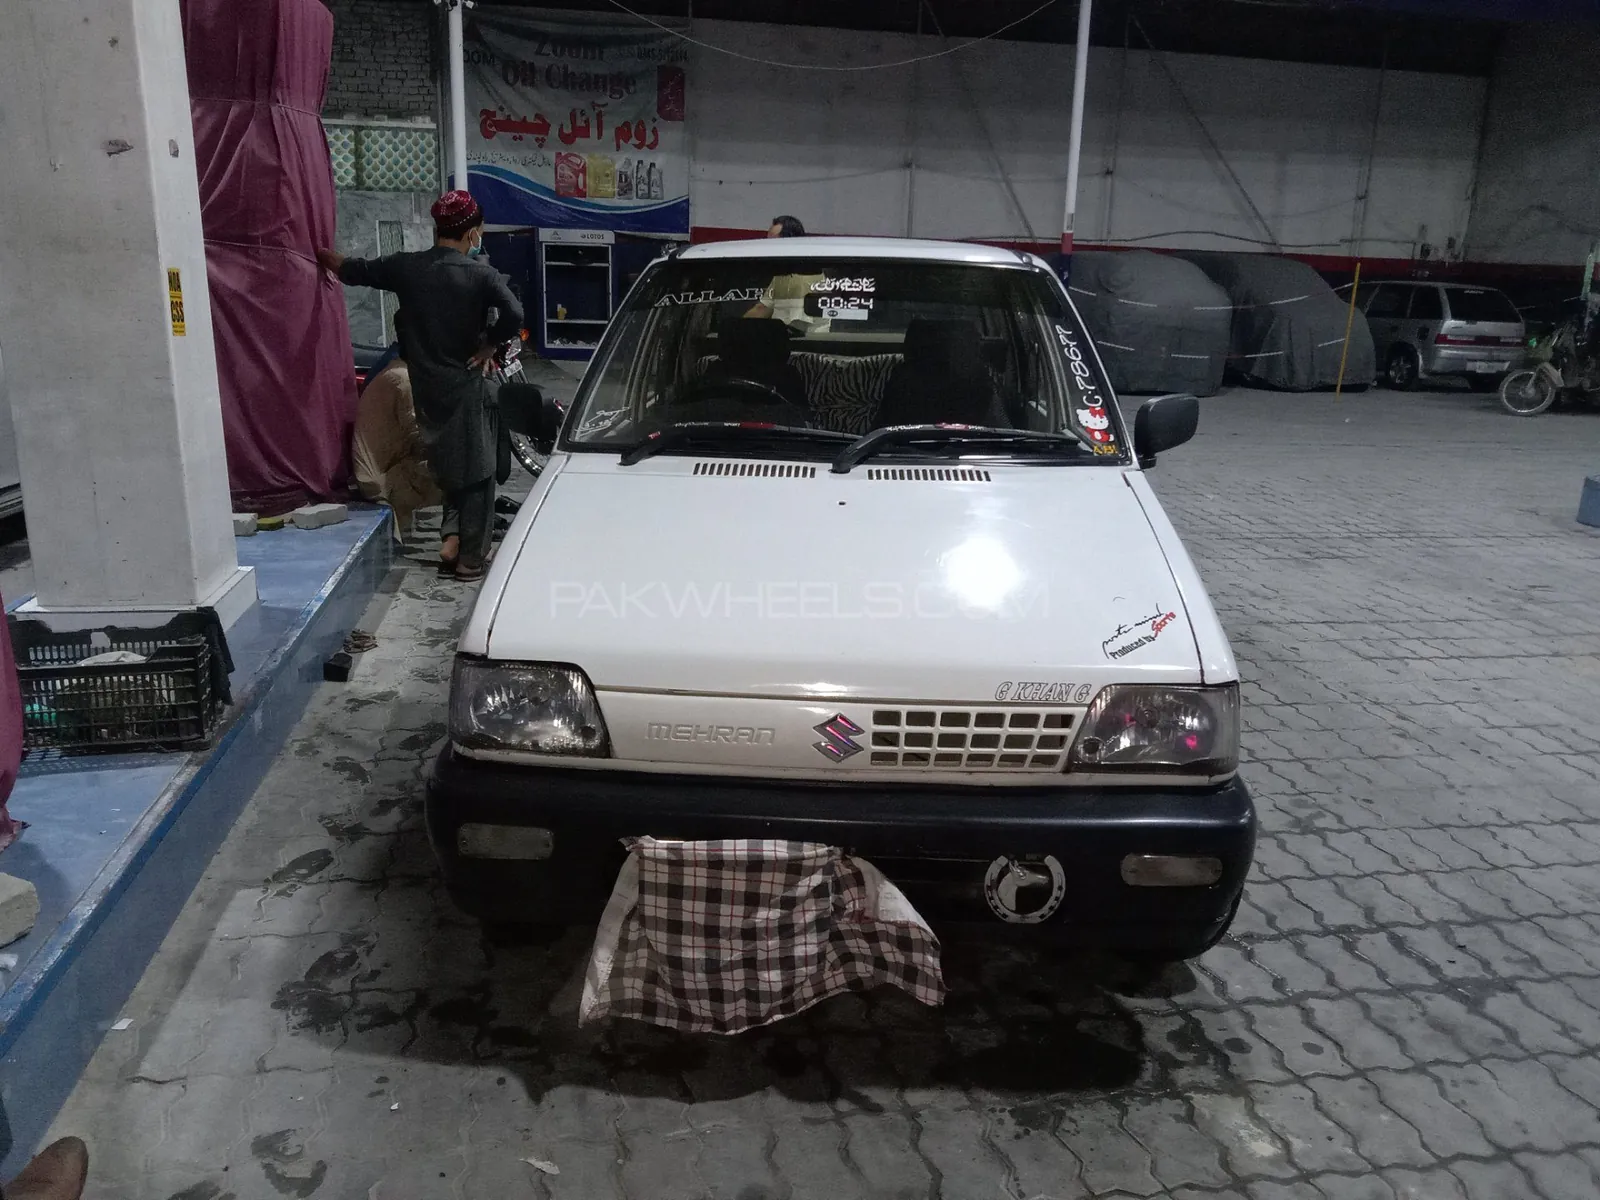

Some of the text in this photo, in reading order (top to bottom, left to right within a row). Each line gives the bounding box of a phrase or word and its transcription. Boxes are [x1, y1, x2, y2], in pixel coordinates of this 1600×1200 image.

[479, 101, 660, 151] زوم آئل چینج
[817, 296, 874, 310] 00:24
[1108, 638, 1146, 660] Produced
[1011, 682, 1076, 703] KHAN
[646, 722, 776, 747] MEHRAN
